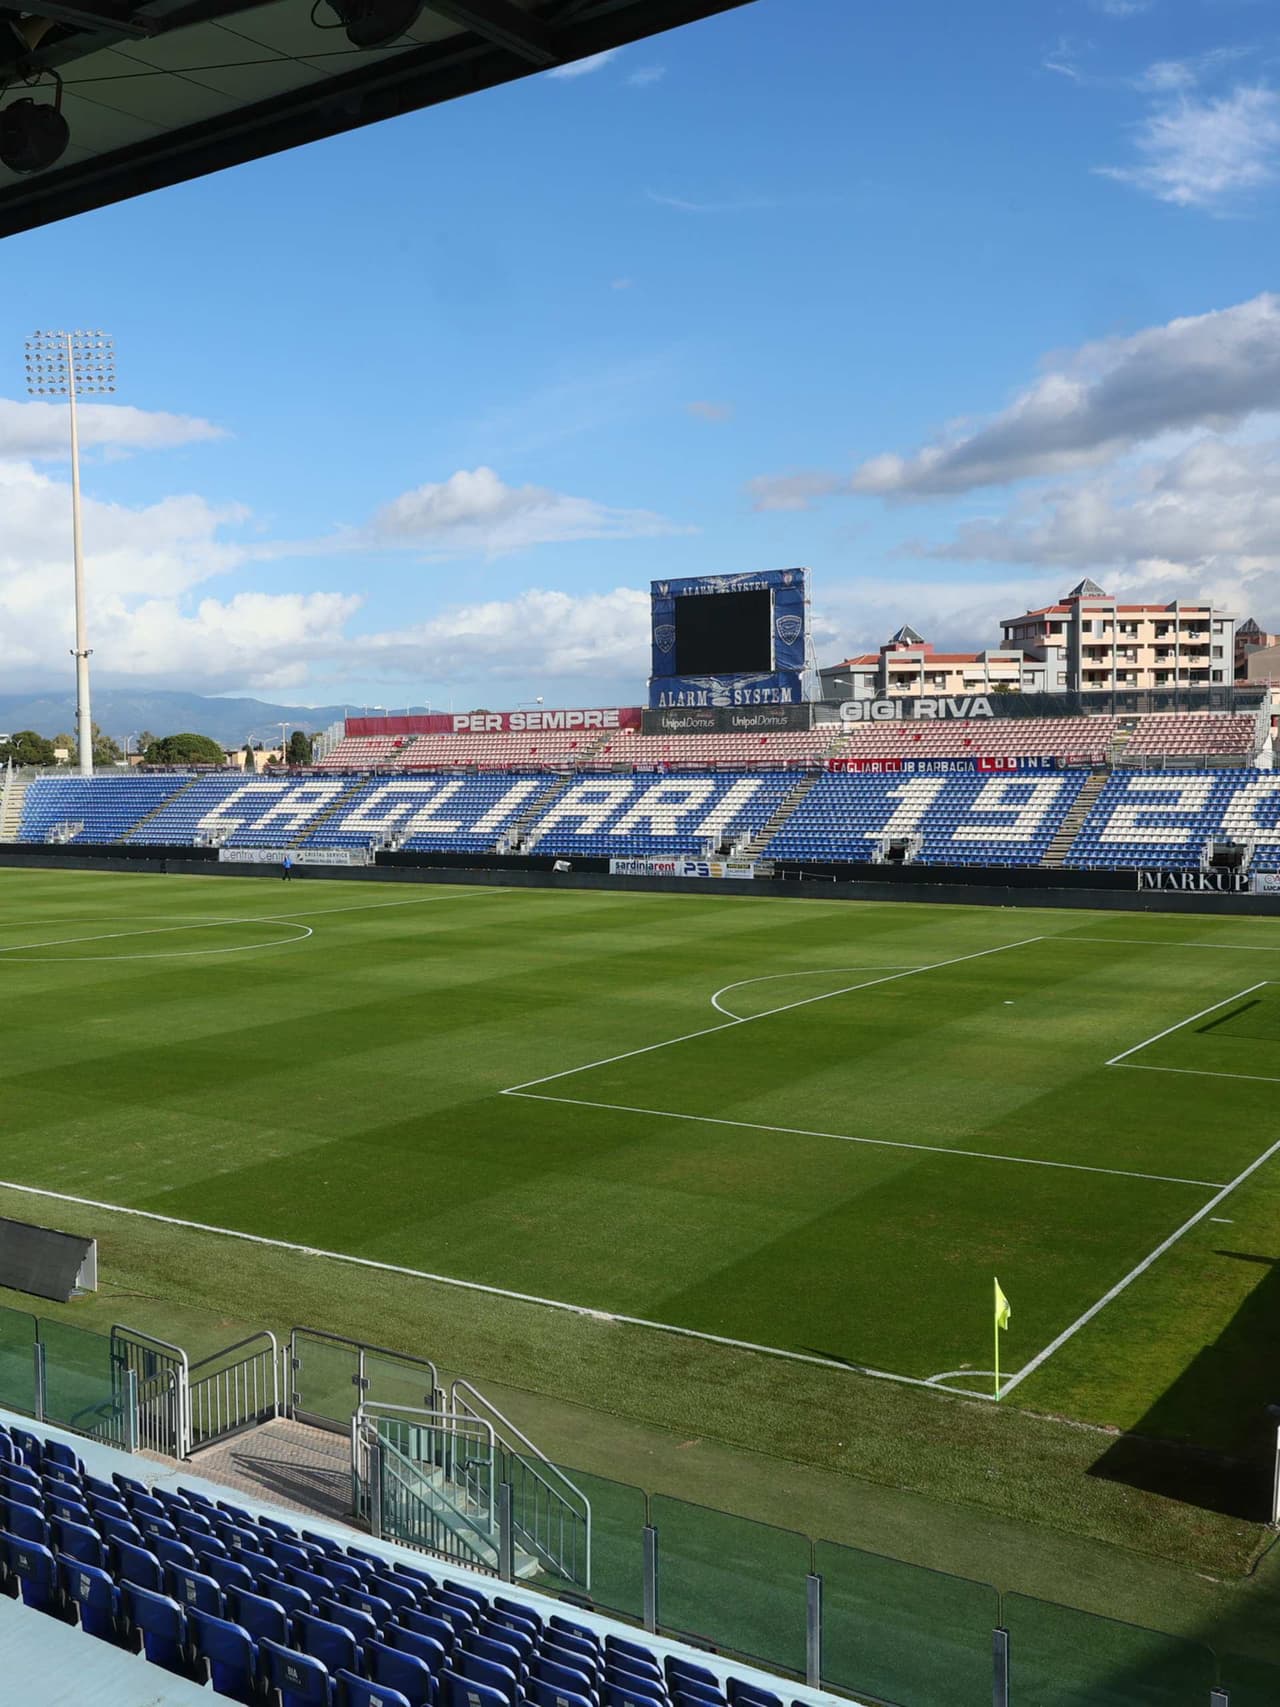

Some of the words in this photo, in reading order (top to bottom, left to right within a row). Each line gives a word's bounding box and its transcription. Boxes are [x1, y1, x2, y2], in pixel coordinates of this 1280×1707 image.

[732, 581, 769, 592] SYSTEM
[659, 690, 708, 707] ALARM
[734, 687, 792, 705] SYSTEM
[839, 699, 903, 721] GIGI
[913, 697, 995, 720] RIVA
[453, 713, 503, 732] PER
[508, 709, 621, 731] SEMPRE
[833, 761, 883, 773] CAGLIARI
[885, 760, 915, 773] CLUB
[918, 760, 975, 773] BARBAGIA
[196, 778, 765, 837] CAGLIARI
[1144, 872, 1249, 892] MARKUP
